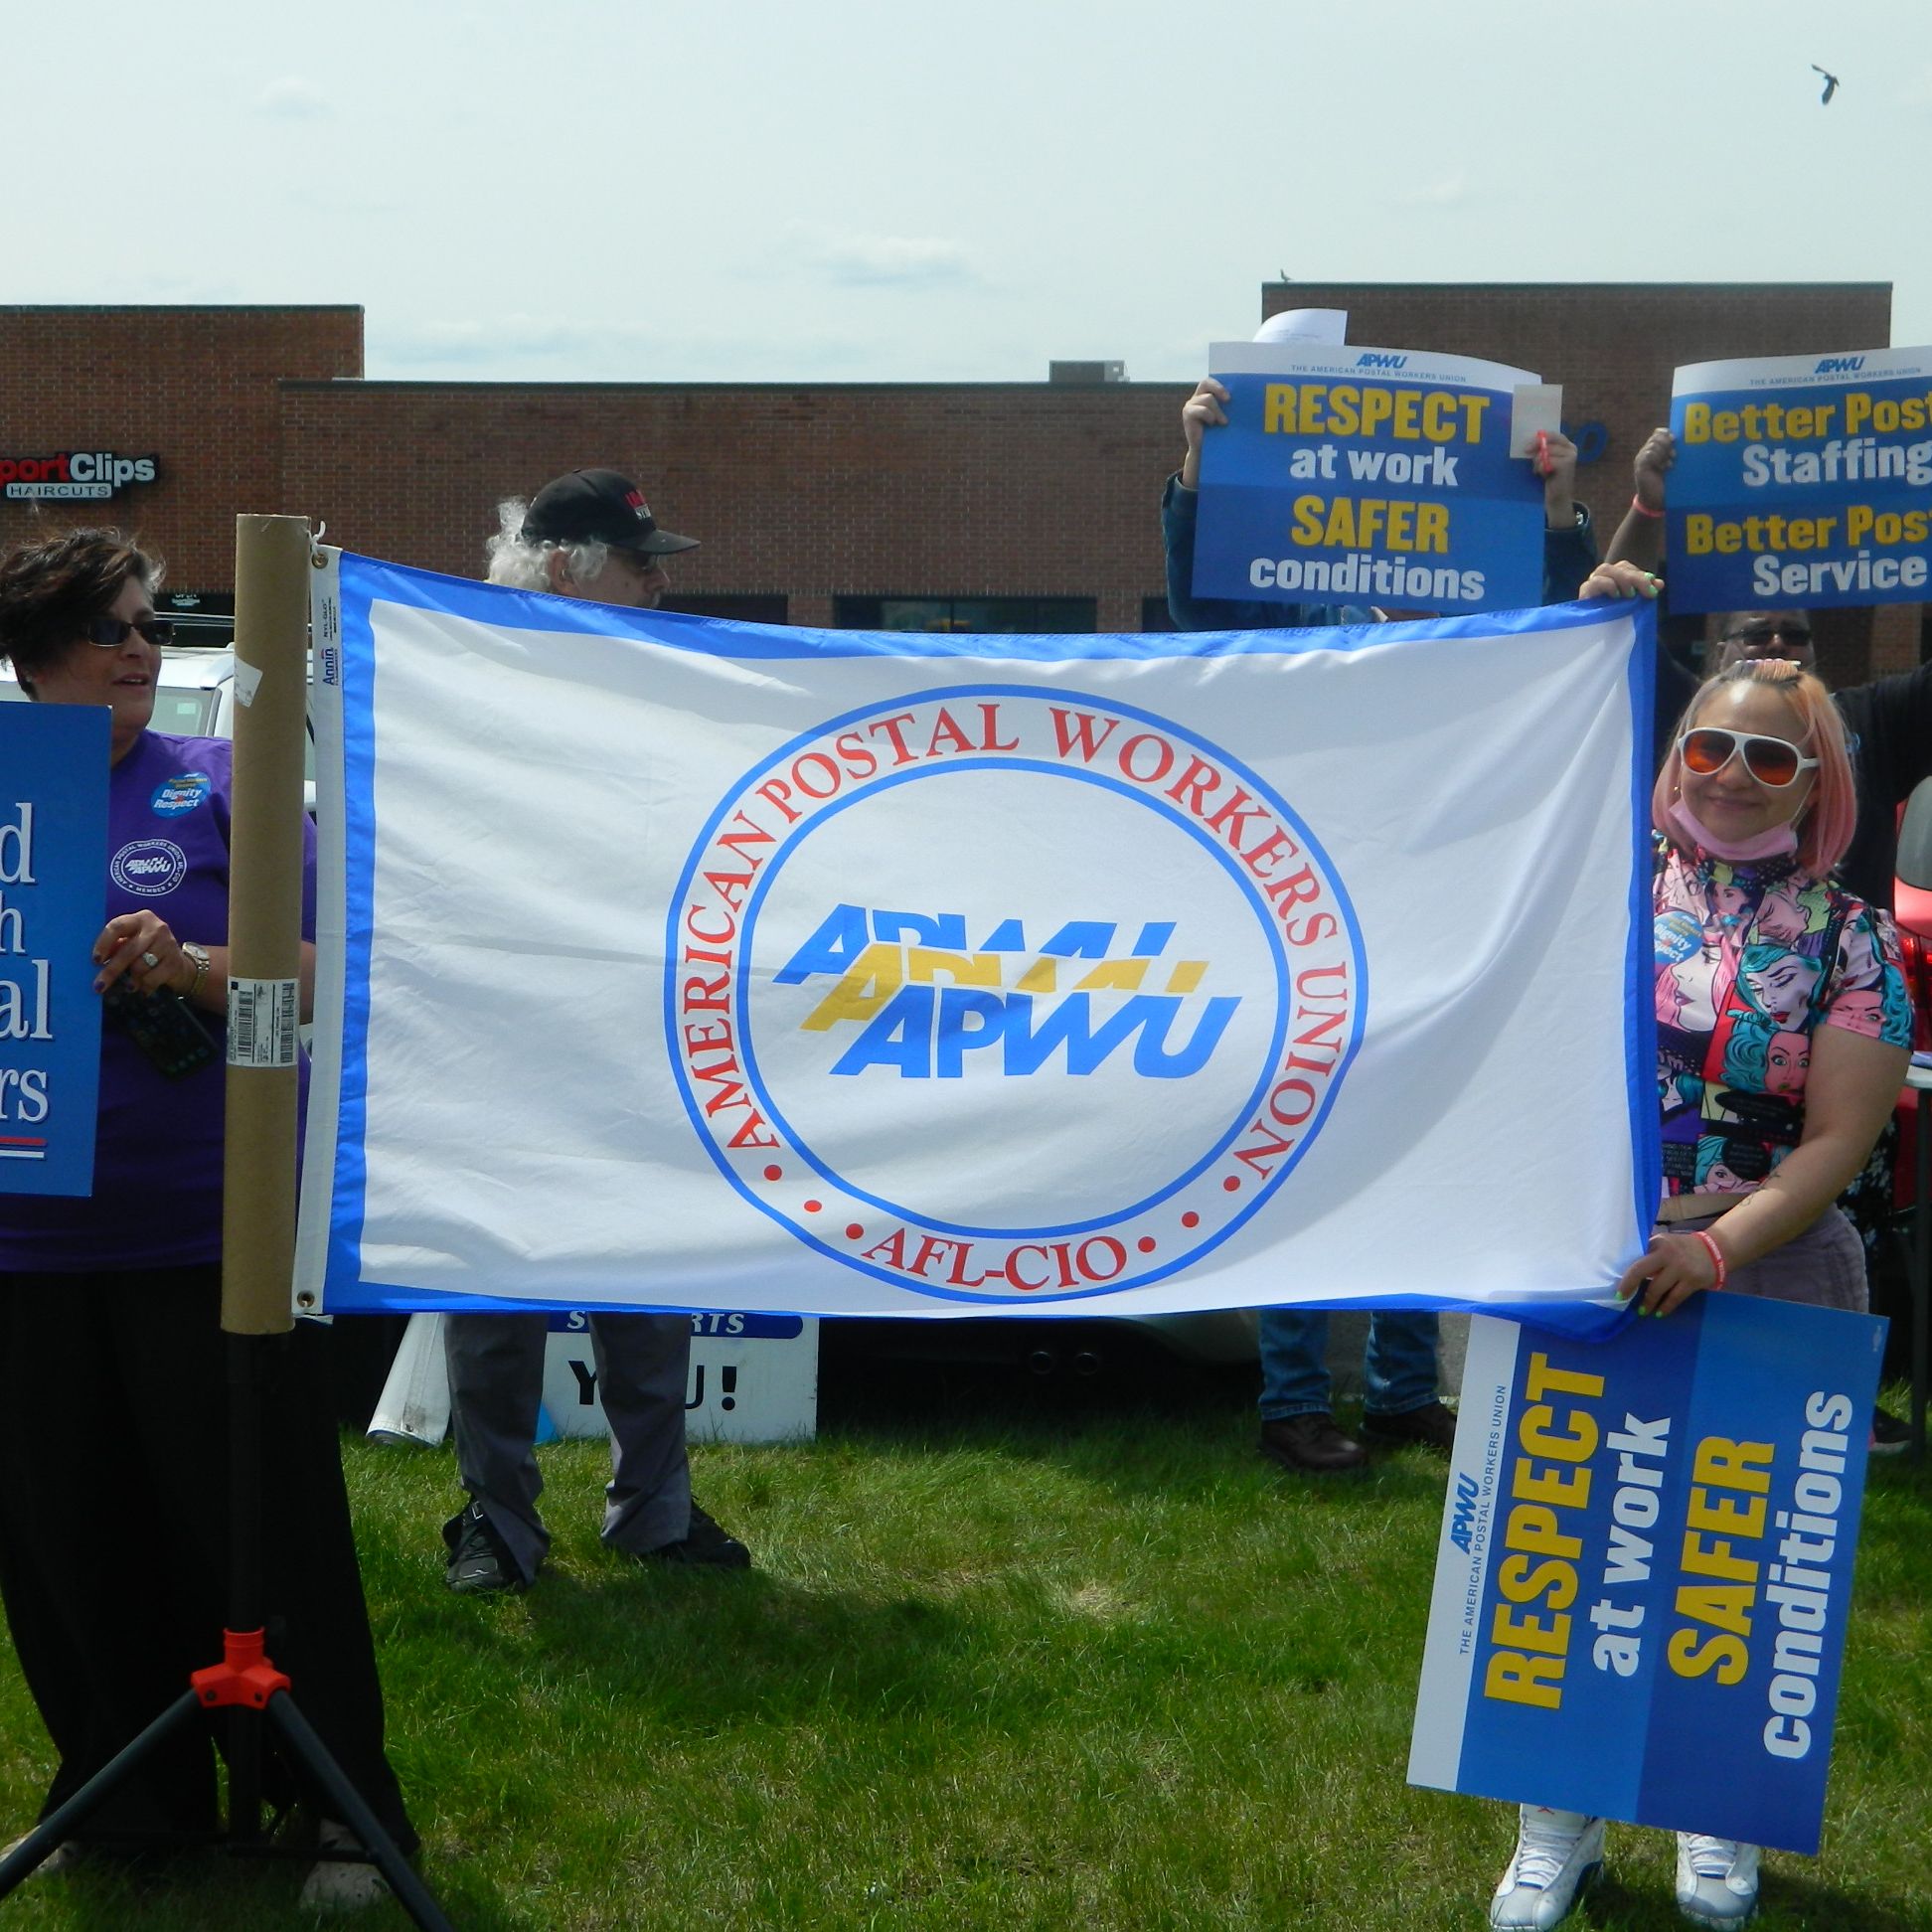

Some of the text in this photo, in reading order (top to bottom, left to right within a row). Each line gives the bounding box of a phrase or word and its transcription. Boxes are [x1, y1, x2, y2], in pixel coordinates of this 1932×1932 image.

[1311, 366, 1356, 375] AMERICAN
[1394, 371, 1436, 380] WORKERS
[1357, 353, 1408, 369] APWU
[1815, 356, 1865, 374] APWU
[1817, 374, 1850, 383] POSTAL
[1853, 370, 1893, 379] WORKERS
[1263, 383, 1491, 444] RESPECT
[1685, 402, 1836, 443] Better
[1289, 443, 1459, 486] at work
[1742, 437, 1932, 486] Staffing
[11, 486, 108, 497] HAIRCUTS
[1290, 494, 1450, 554] SAFER
[1687, 505, 1932, 554] Better Pos
[1249, 553, 1487, 600] conditions
[1753, 550, 1927, 596] Service
[322, 647, 334, 686] Annin
[153, 798, 200, 810] Respect
[162, 787, 202, 799] Dignity
[684, 704, 1349, 1181] AMERICAN POSTAL WORKERS UNION
[829, 985, 1242, 1079] APWU
[862, 1225, 1128, 1292] AFL-CIO
[1450, 1472, 1480, 1555] APWU
[1459, 1384, 1507, 1656] THE AMERICAN POSTAL WORKERS UNION
[1483, 1352, 1606, 1710] RESPECT
[1589, 1412, 1672, 1678] at work
[1667, 1436, 1775, 1687] SAFER
[1763, 1390, 1854, 1760] conditions
